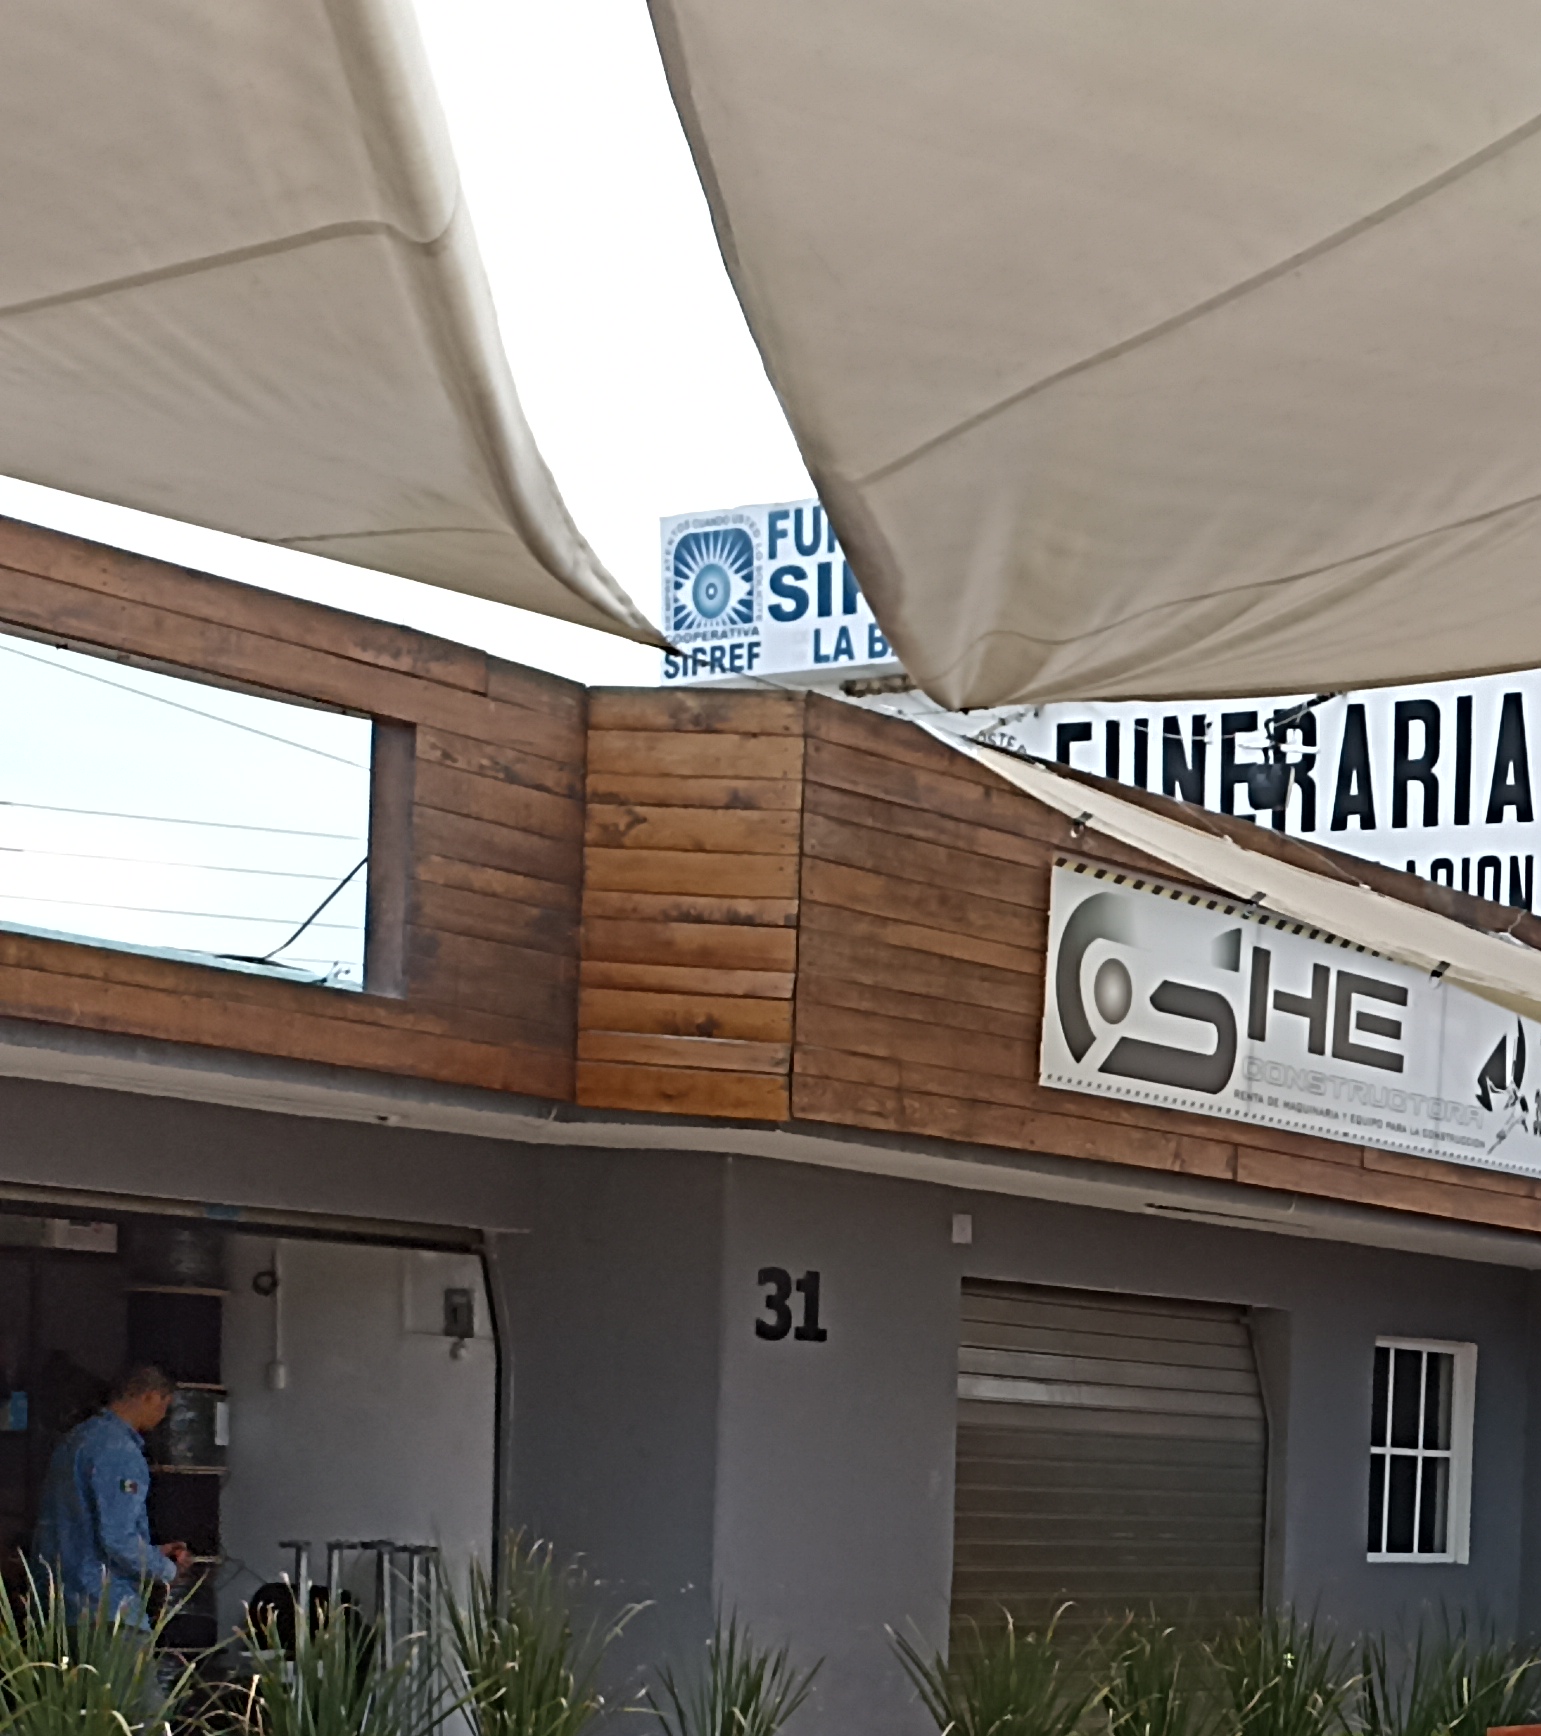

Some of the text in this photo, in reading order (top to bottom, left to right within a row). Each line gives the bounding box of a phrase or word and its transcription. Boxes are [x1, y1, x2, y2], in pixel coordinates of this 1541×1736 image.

[664, 626, 760, 646] COOPERATIVA
[813, 623, 896, 664] LA B
[663, 641, 761, 680] SIPREF
[1233, 1089, 1264, 1104] RENTA
[1267, 1095, 1279, 1108] DE
[1350, 1113, 1384, 1129] EQUIPO
[1242, 1056, 1485, 1129] CONSTRUCTORA
[756, 1267, 828, 1342] 31
